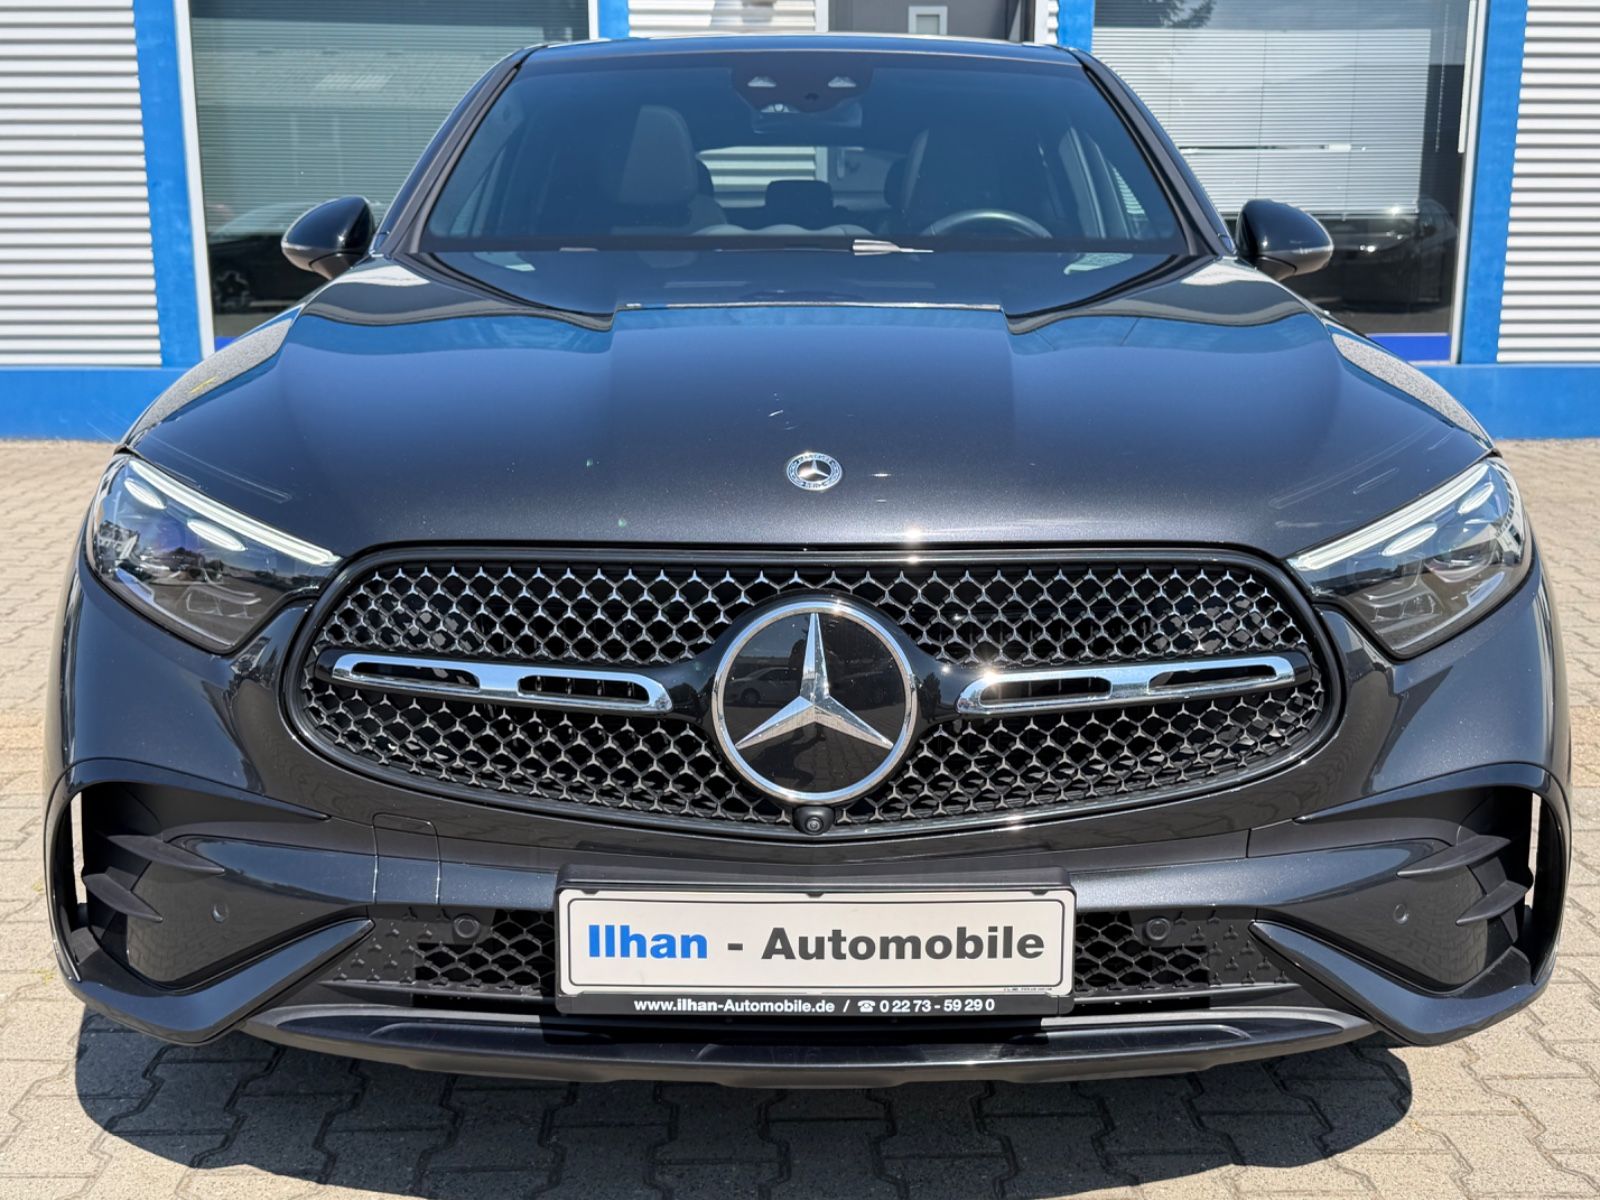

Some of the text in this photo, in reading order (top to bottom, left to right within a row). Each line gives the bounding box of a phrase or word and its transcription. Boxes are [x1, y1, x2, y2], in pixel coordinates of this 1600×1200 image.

[588, 924, 708, 959] Ilhan
[761, 925, 1045, 960] Automobile
[633, 998, 836, 1013] www.ilhan-Automobile.de
